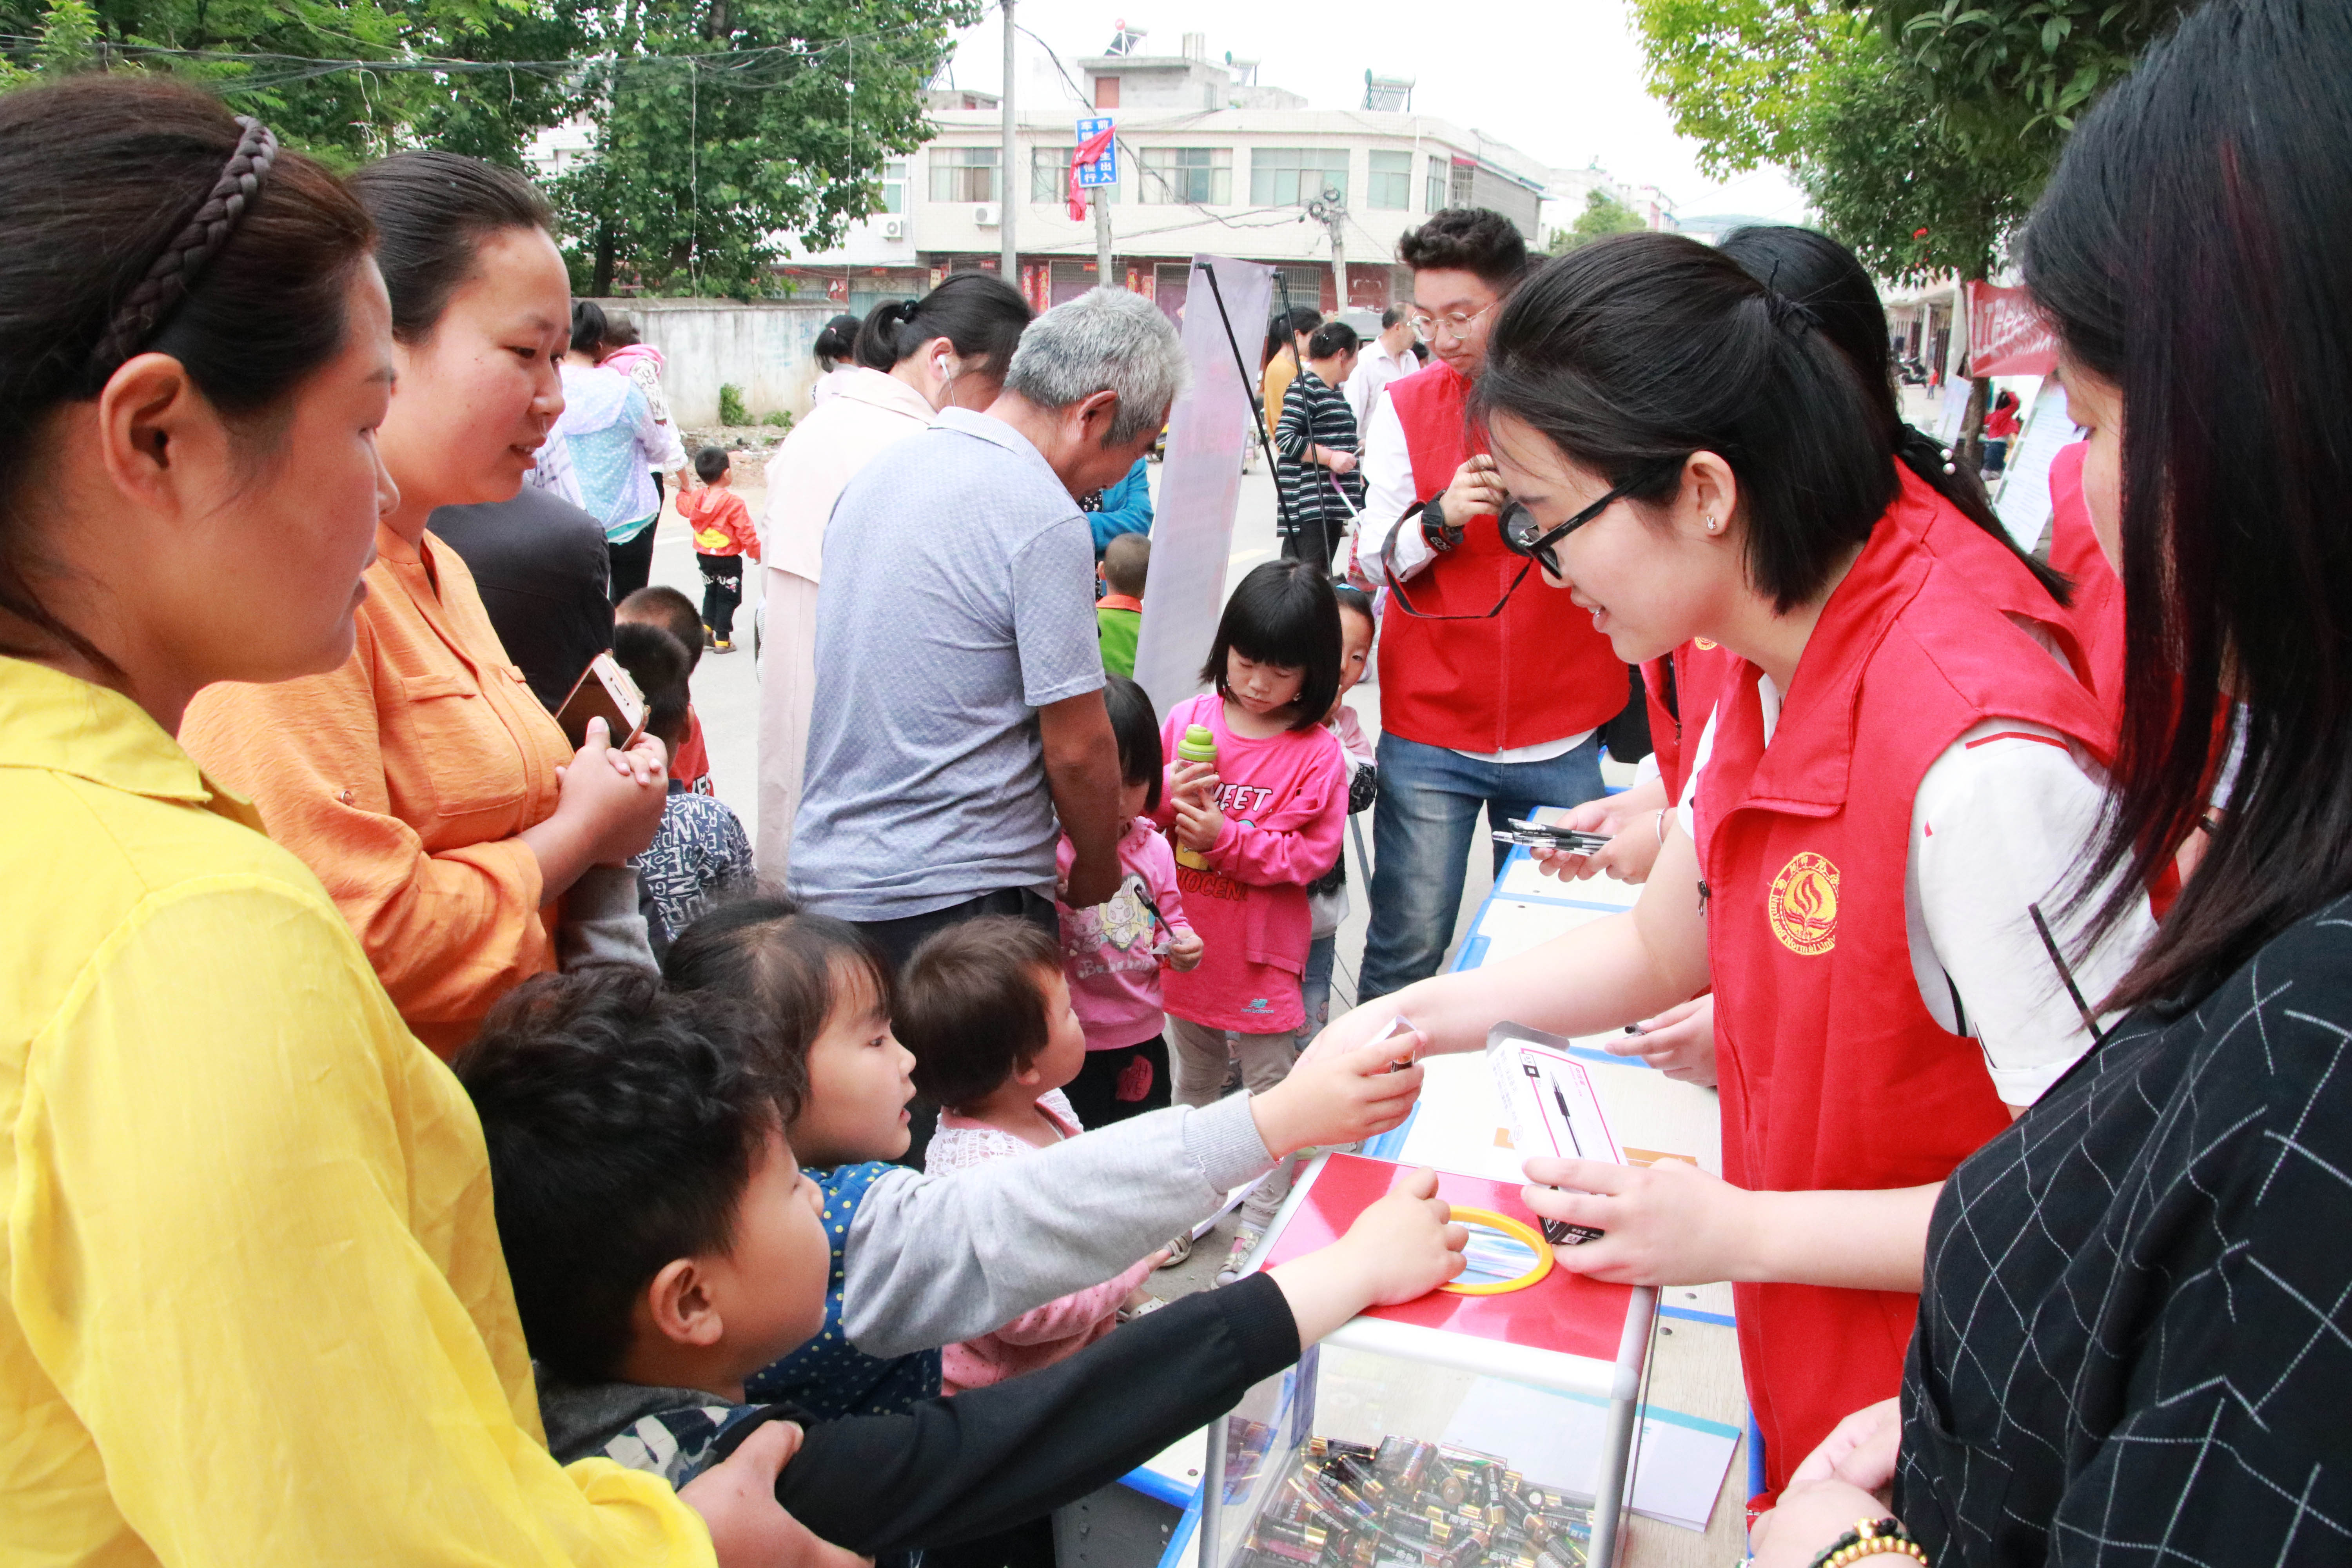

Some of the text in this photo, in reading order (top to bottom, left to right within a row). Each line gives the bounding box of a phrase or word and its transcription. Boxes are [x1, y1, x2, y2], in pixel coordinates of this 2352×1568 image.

[1081, 121, 1096, 183] 车辆慢行
[1097, 120, 1112, 181] 前生出入
[1176, 868, 1248, 901] NOCEN
[1785, 936, 1817, 953] Normal
[1817, 935, 1836, 950] Univ
